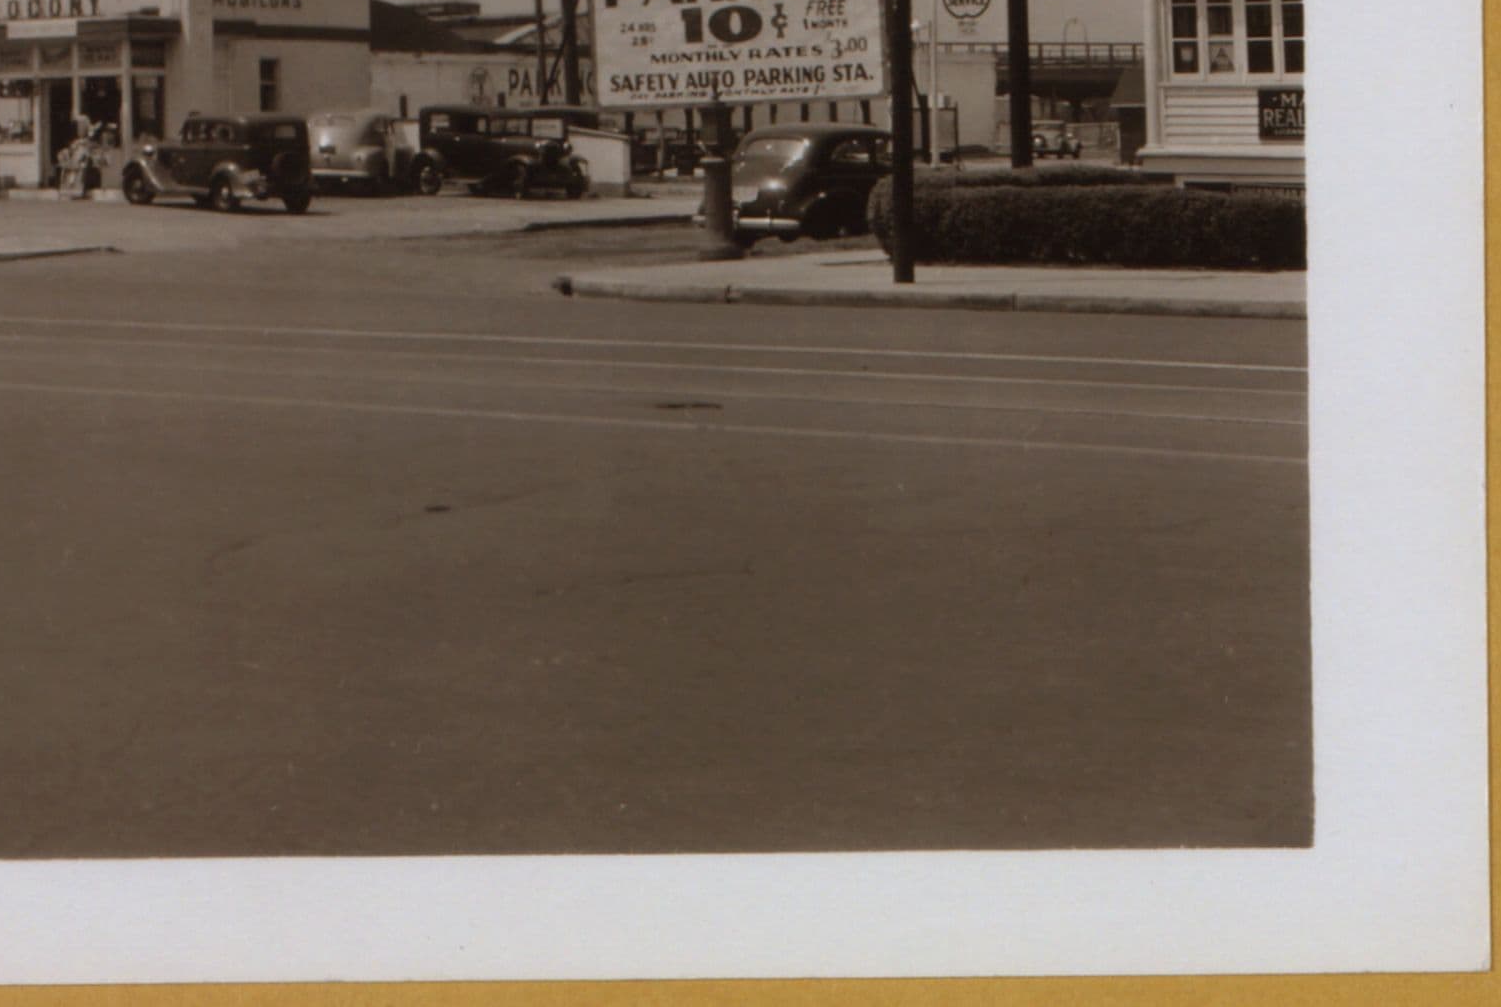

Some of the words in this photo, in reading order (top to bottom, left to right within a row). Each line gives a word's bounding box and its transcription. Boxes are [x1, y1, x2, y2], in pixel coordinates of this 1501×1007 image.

[620, 22, 635, 34] 24
[650, 48, 741, 65] MONTHLY
[748, 43, 823, 60] RATES
[610, 72, 681, 93] SAFETY
[686, 69, 735, 90] AUTO
[744, 65, 825, 86] PARKING
[833, 62, 875, 82] STA.
